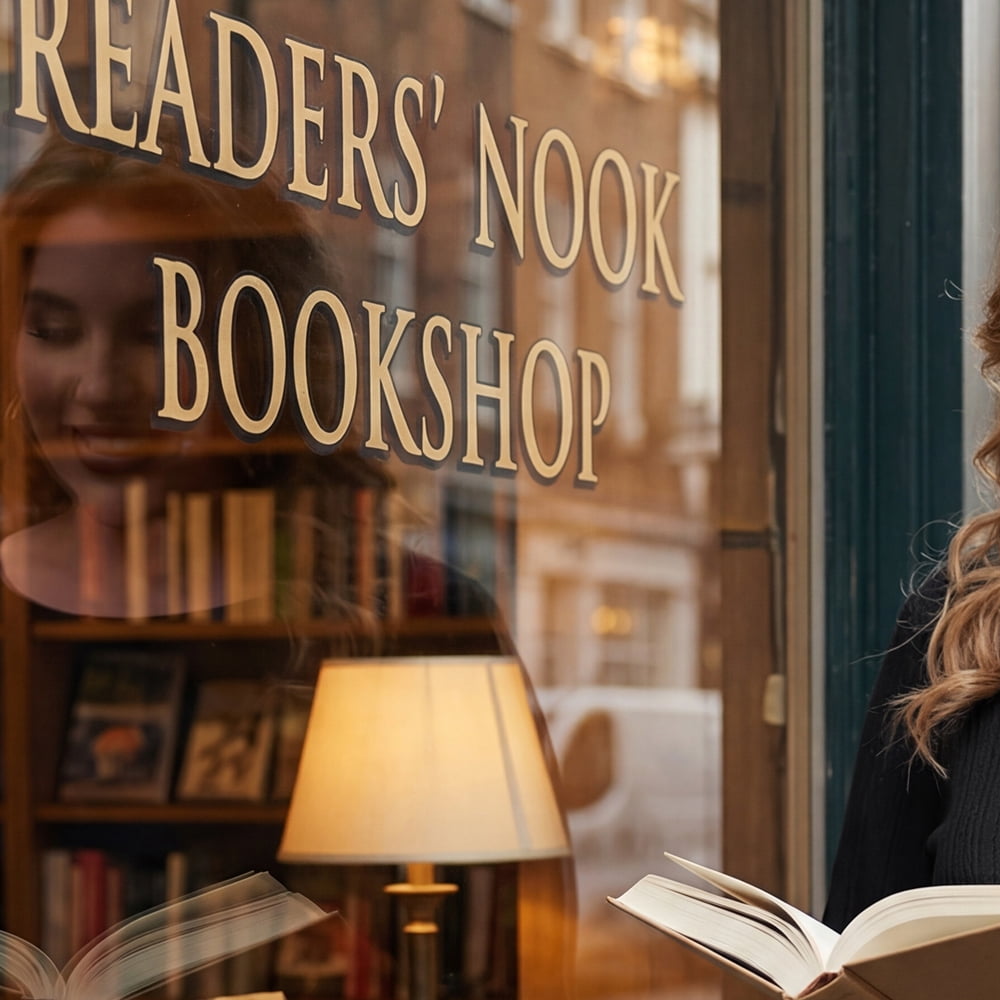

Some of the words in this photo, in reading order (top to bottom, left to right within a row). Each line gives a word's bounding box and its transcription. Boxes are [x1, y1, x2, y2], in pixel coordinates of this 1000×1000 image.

[14, 0, 445, 228] READERS'
[474, 101, 685, 303] NOOK
[153, 256, 611, 484] BOOKSHOP
